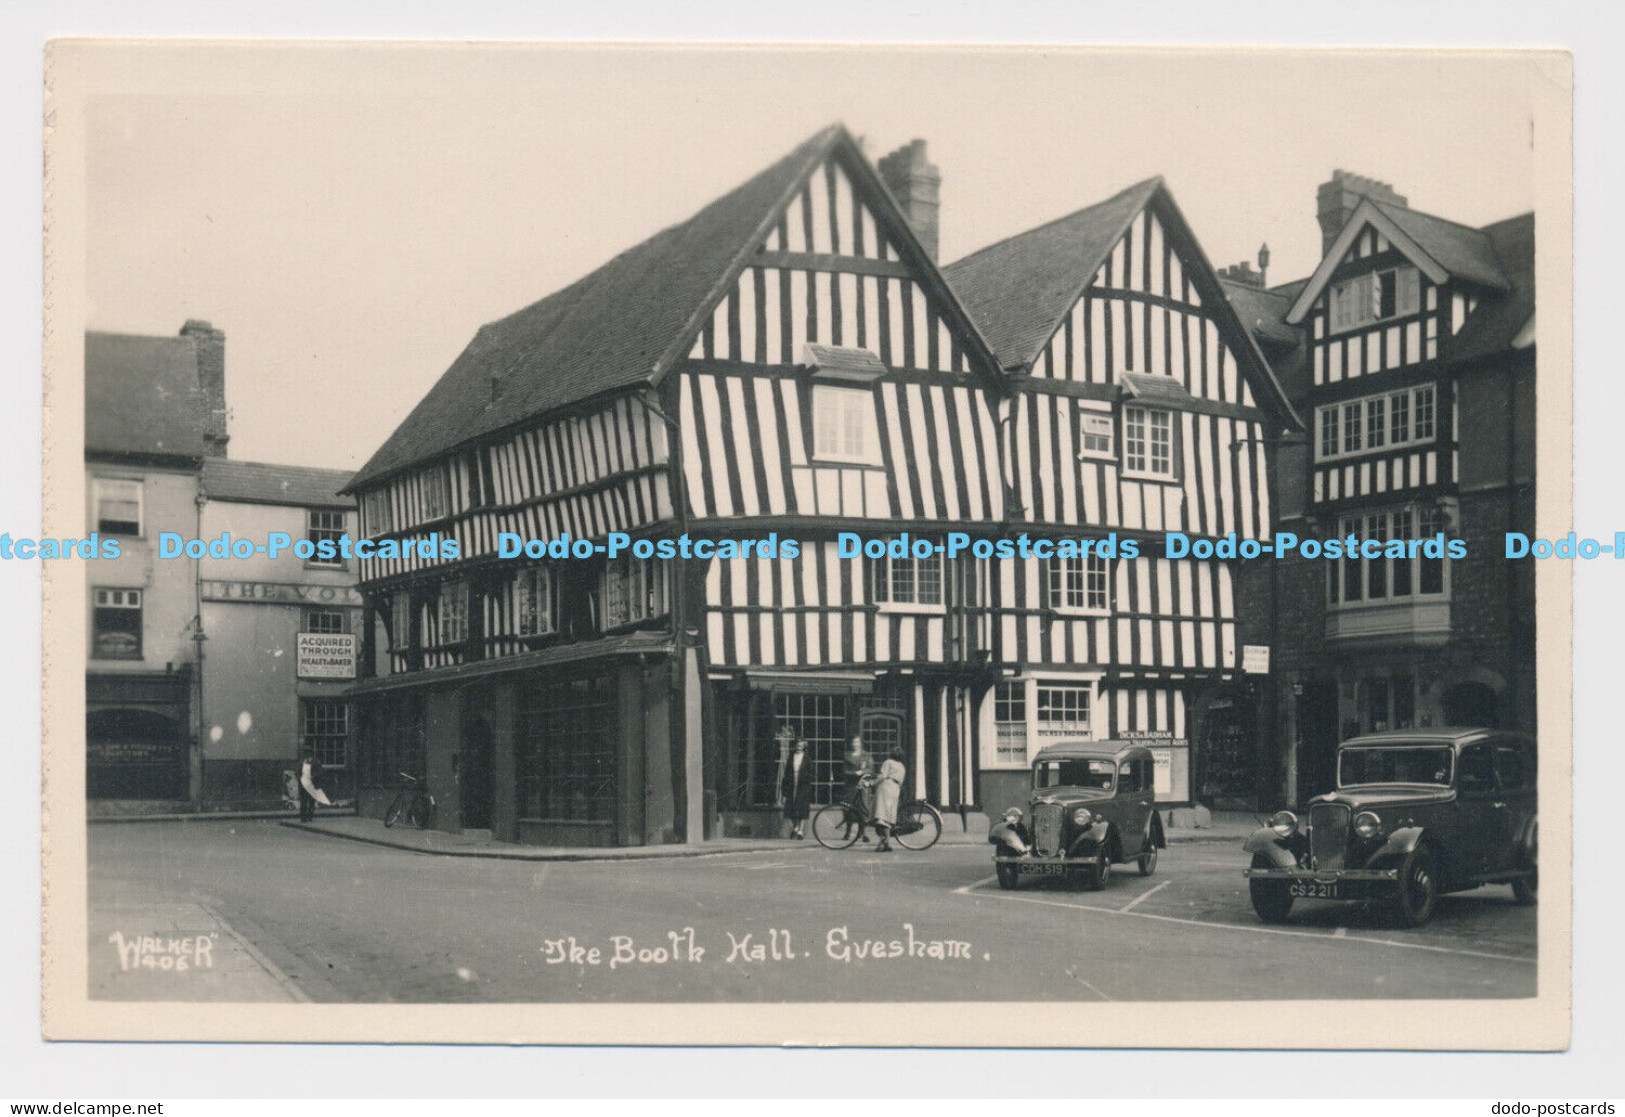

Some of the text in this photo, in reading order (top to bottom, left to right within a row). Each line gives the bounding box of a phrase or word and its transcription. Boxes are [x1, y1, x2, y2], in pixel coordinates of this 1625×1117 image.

[223, 583, 276, 599] THE
[300, 637, 352, 646] ACQUIRED
[300, 647, 352, 655] THROUGH
